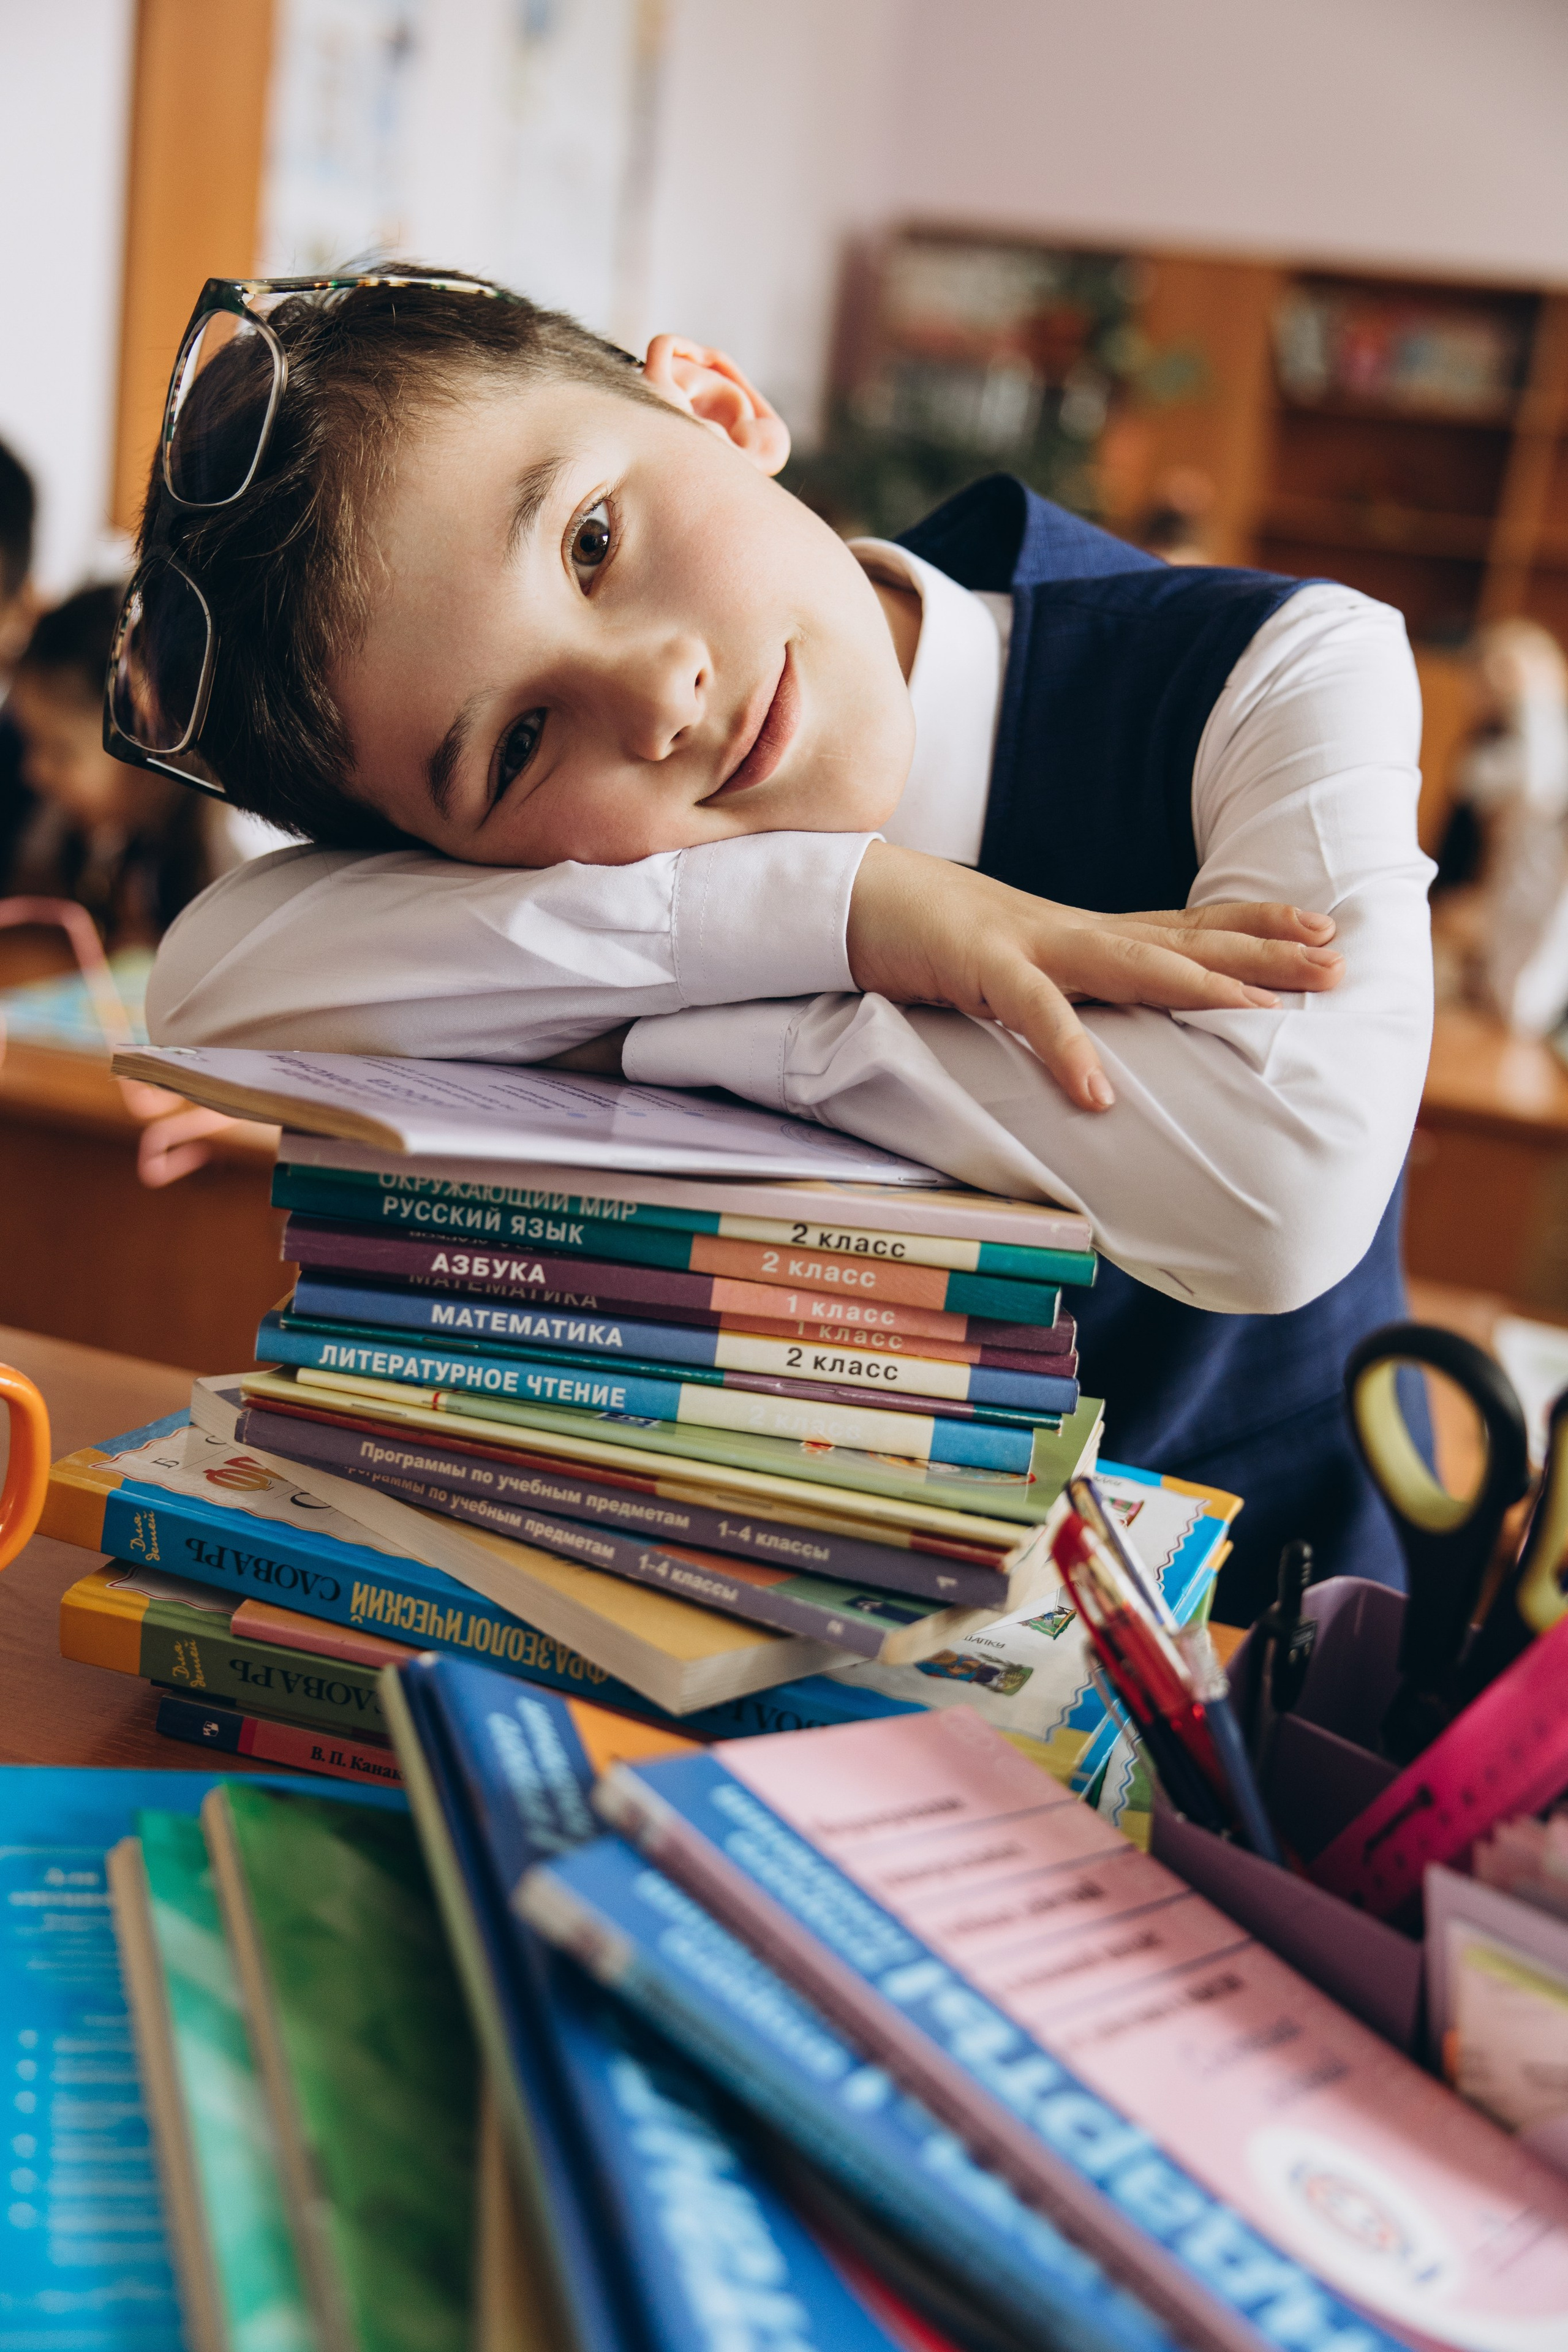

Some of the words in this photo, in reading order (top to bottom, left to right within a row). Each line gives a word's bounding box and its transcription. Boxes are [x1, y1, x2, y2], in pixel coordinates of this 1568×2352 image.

[382, 1196, 501, 1232] РУССКИЙ
[510, 1215, 585, 1245] ЯЗЫК
[579, 1196, 637, 1222] МИР
[791, 1222, 809, 1245] 2
[818, 1232, 906, 1258] класс
[430, 1253, 546, 1284] АЗБУКА
[761, 1251, 780, 1273] 2
[788, 1259, 876, 1289] класс
[431, 1303, 624, 1348] МАТЕМАТИКА
[786, 1294, 798, 1314] 1
[811, 1300, 895, 1325] класс
[818, 1324, 903, 1350] класс
[318, 1344, 519, 1393] ЛИТЕРАТУРНОЕ
[527, 1373, 627, 1409] ЧТЕНИЕ
[786, 1347, 803, 1368] 2
[812, 1355, 899, 1381] класс
[360, 1440, 467, 1478] Программы
[470, 1468, 494, 1485] по
[497, 1474, 581, 1506] учебным
[585, 1491, 690, 1530] предметам
[755, 1530, 831, 1562] классы
[129, 1512, 146, 1553] Для
[143, 1510, 161, 1561] детей
[428, 1485, 448, 1502] по
[450, 1492, 521, 1528] учебным
[524, 1517, 616, 1559] предметам
[670, 1569, 739, 1602] классы
[186, 1537, 342, 1602] СЛОВАРЬ
[350, 1580, 609, 1685] ФРАЗЕОЛОГИЧЕСКИЙ
[311, 1745, 326, 1762] В.
[329, 1750, 347, 1768] П.
